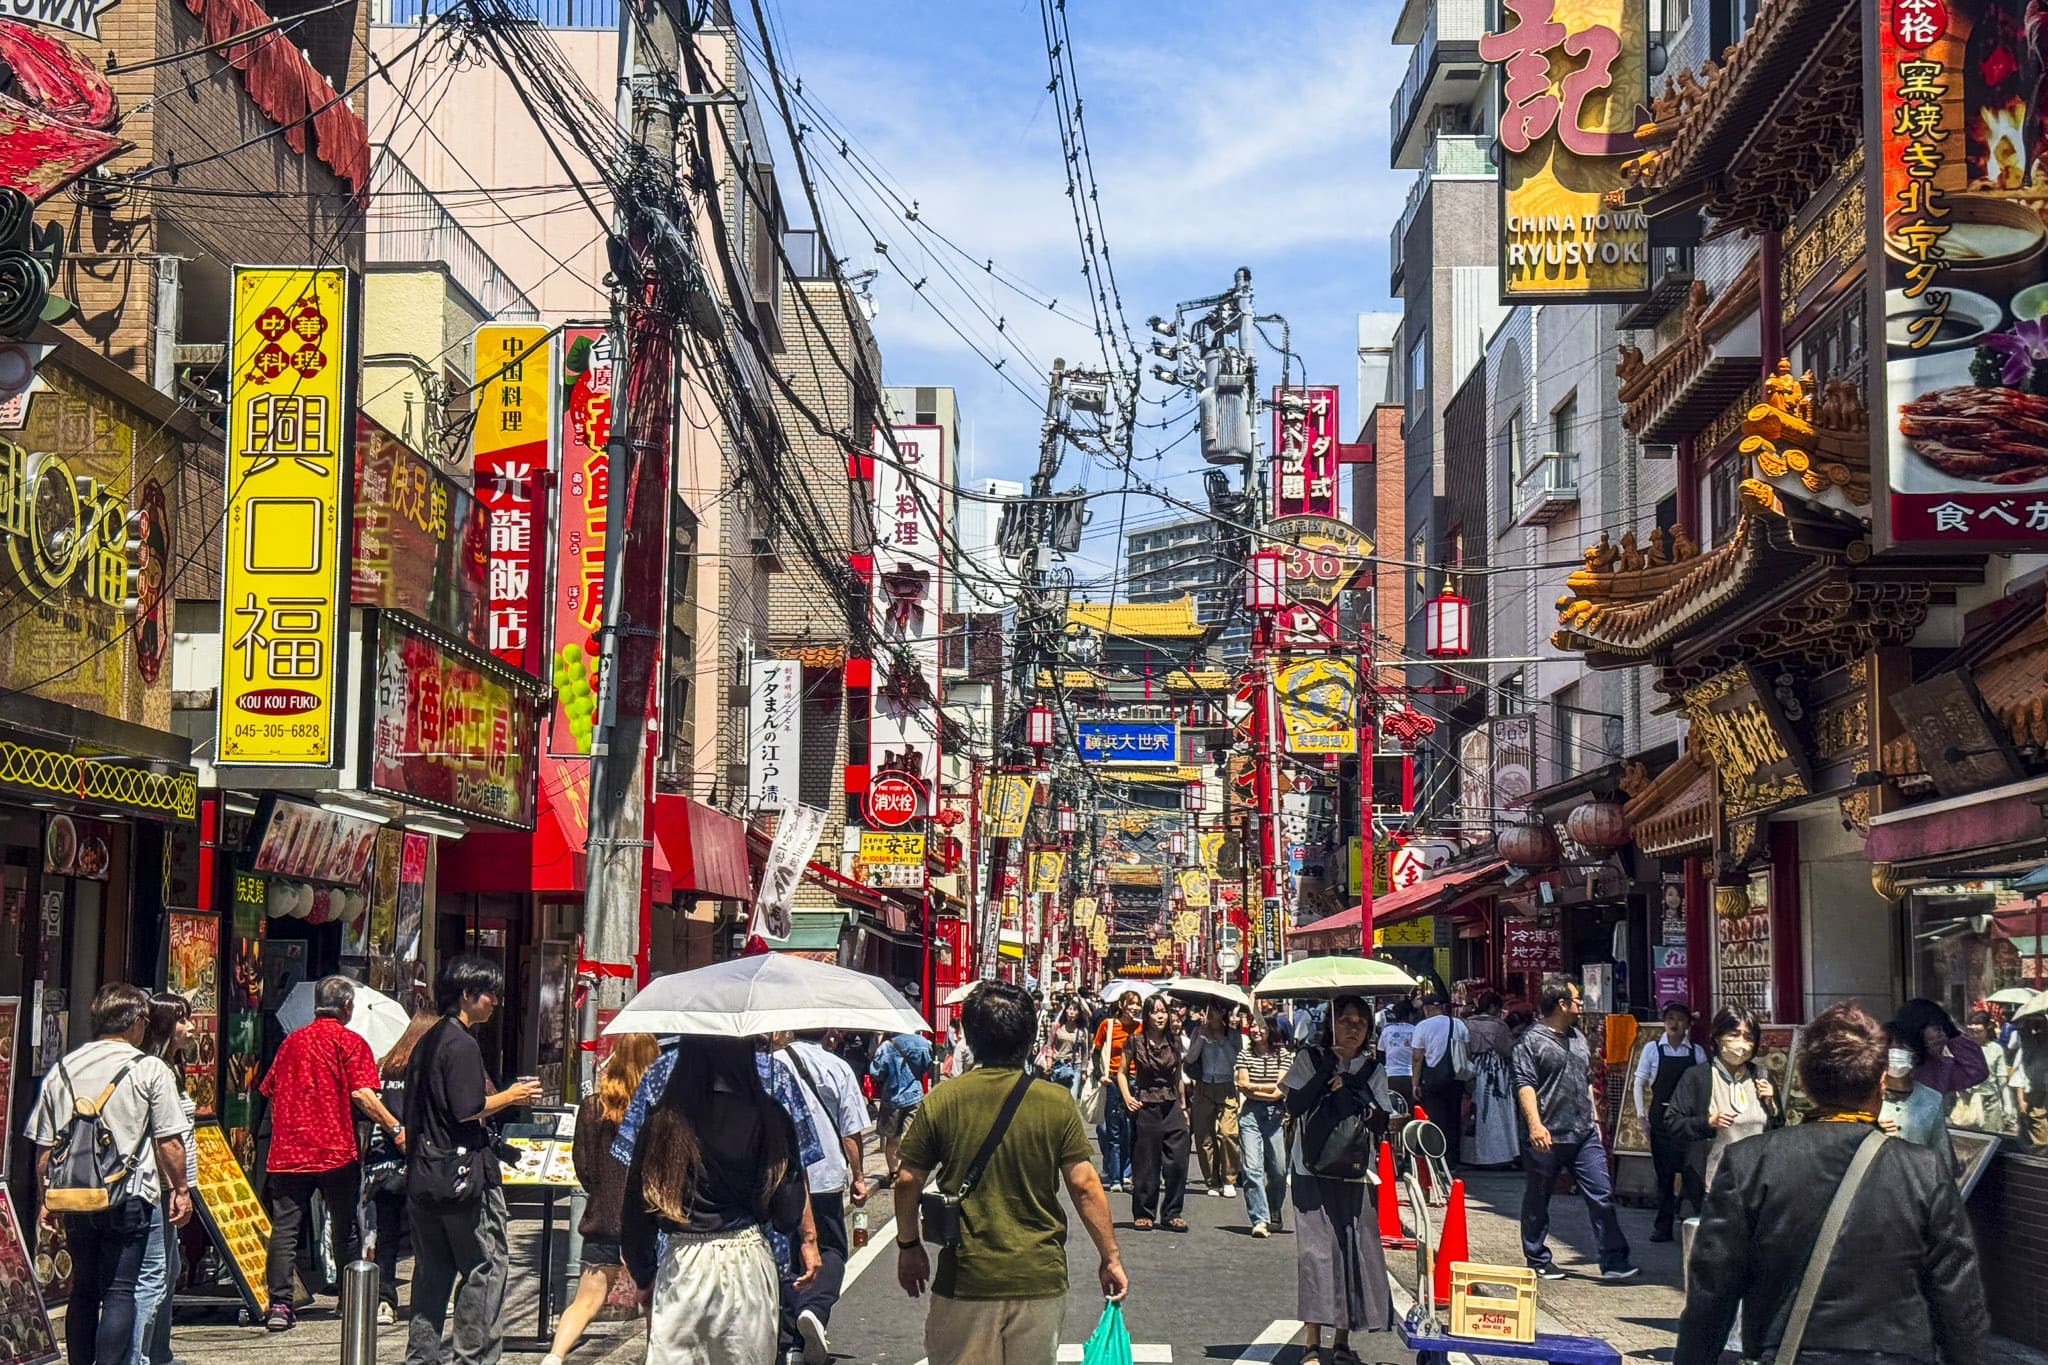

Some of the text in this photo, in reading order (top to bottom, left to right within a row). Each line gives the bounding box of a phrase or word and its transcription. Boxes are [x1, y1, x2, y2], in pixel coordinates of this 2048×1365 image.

[1508, 213, 1648, 232] CHINA TOWN
[1509, 242, 1648, 266] RYUSYOKI
[260, 312, 322, 338] 中華
[259, 350, 322, 377] 料理
[1281, 395, 1305, 499] 食べ放題
[1310, 396, 1332, 498] オーダー式
[894, 441, 919, 546] 四川料理
[232, 393, 333, 681] 興口福
[490, 461, 531, 651] 光龍飯店
[239, 695, 318, 710] KOU KOU FUKU
[235, 724, 320, 738] 045-305-6828
[760, 668, 781, 803] ブタまんの江戸清
[874, 794, 913, 812] 消火栓
[884, 835, 921, 855] 安記
